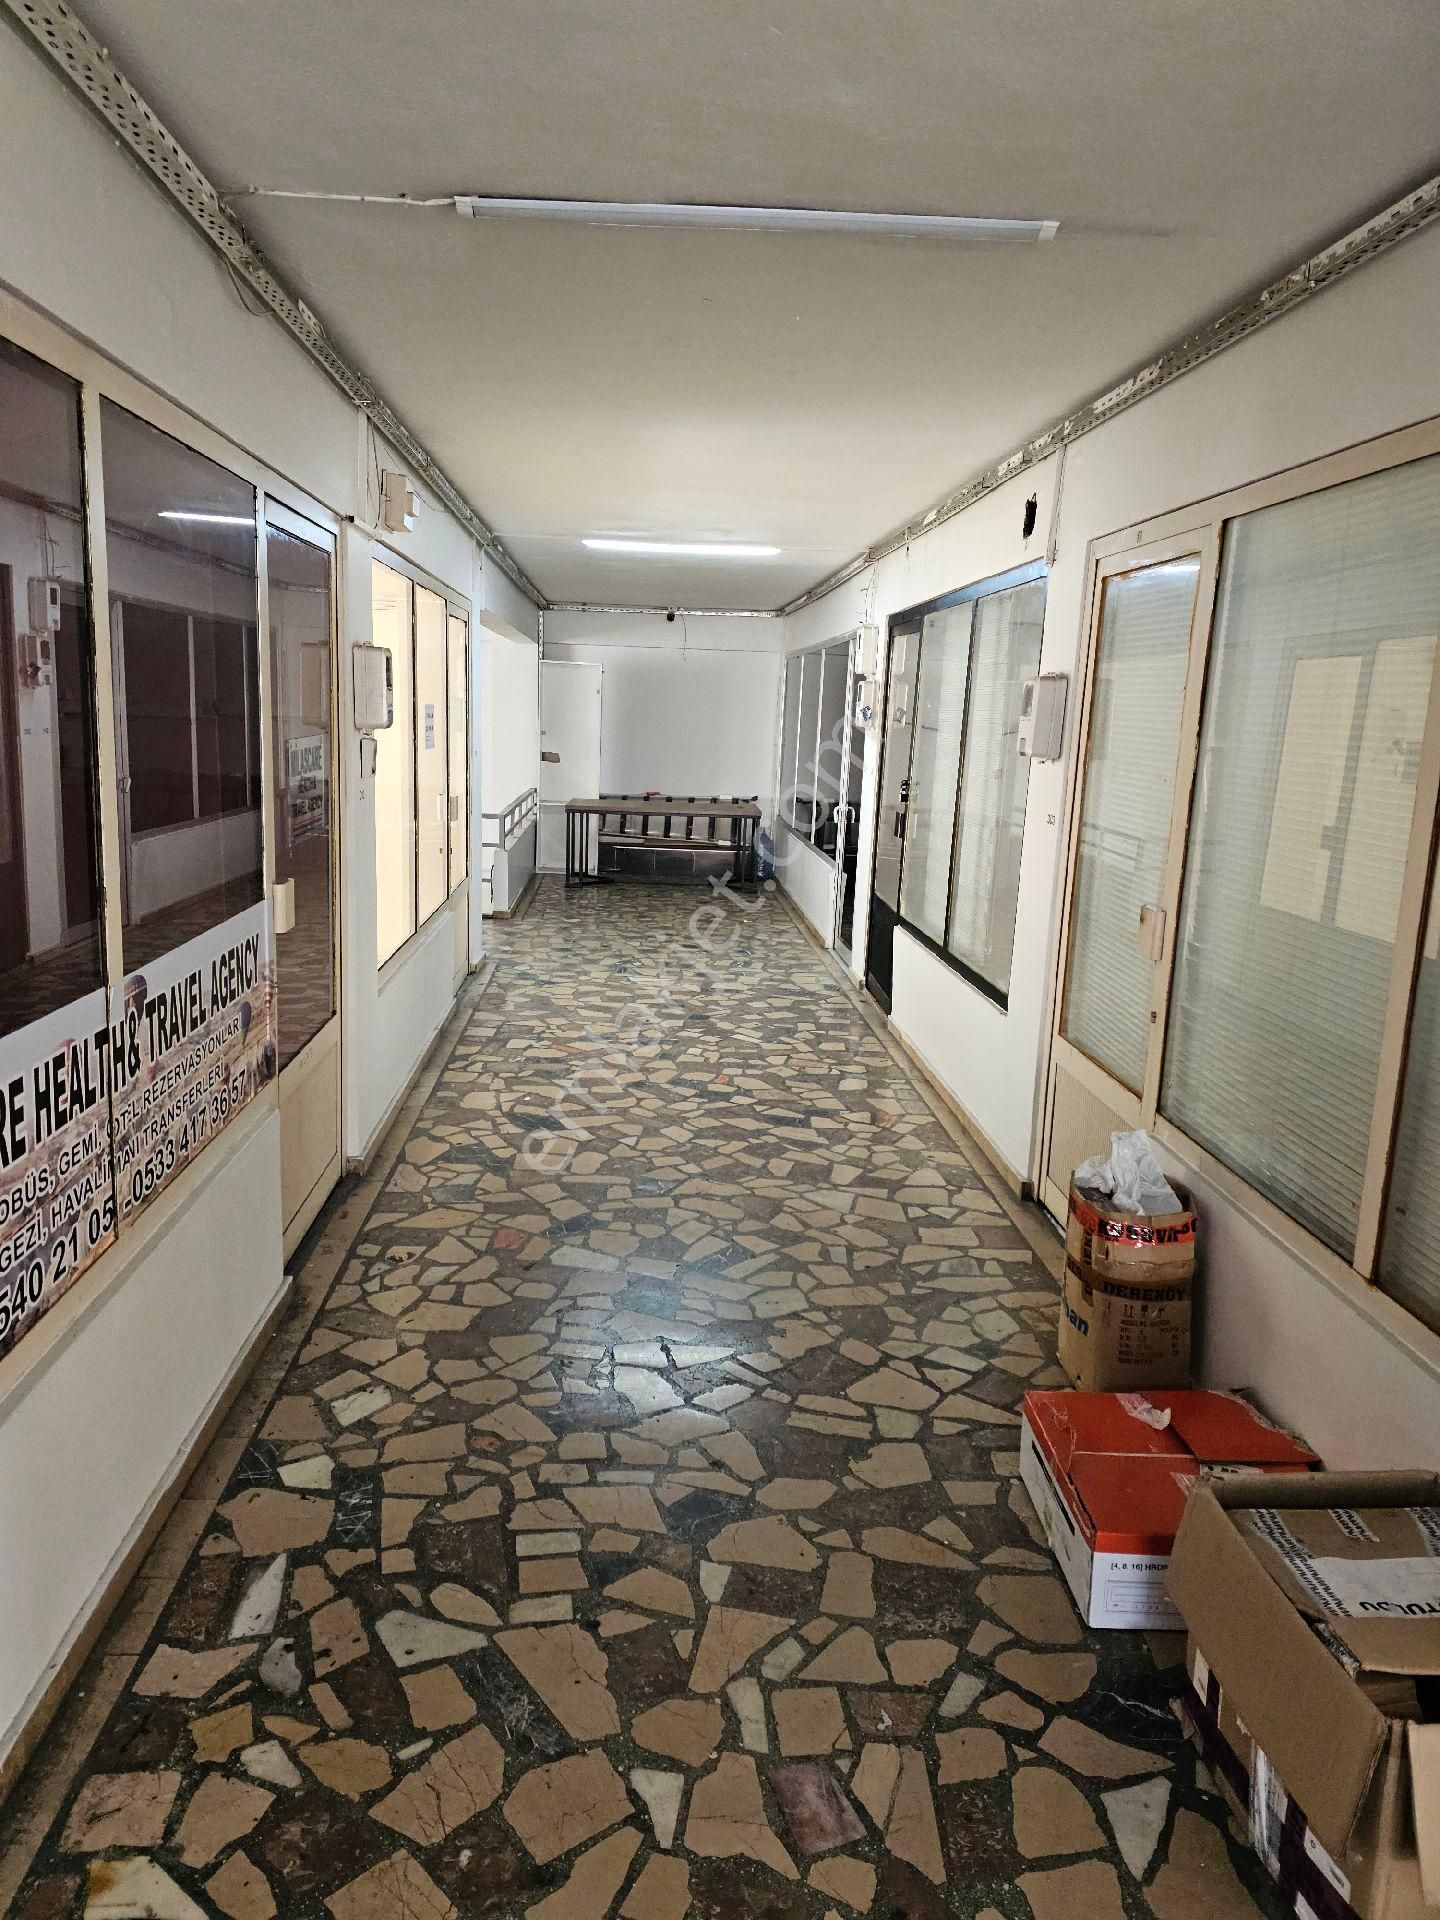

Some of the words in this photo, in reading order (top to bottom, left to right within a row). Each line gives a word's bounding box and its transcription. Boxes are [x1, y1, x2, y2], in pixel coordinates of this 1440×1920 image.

[145, 969, 206, 1063] TRAVEL
[210, 933, 259, 1018] AGENCY
[0, 1212, 47, 1272] GEZİ,
[143, 1058, 224, 1146] TRANSFERLERİ
[0, 1260, 43, 1334] 540
[52, 1225, 78, 1284] 21
[88, 1193, 114, 1245] 05
[180, 1106, 207, 1153] 417
[212, 1088, 228, 1124] 36
[232, 1069, 246, 1104] 57
[59, 1124, 102, 1176] GEMİ,
